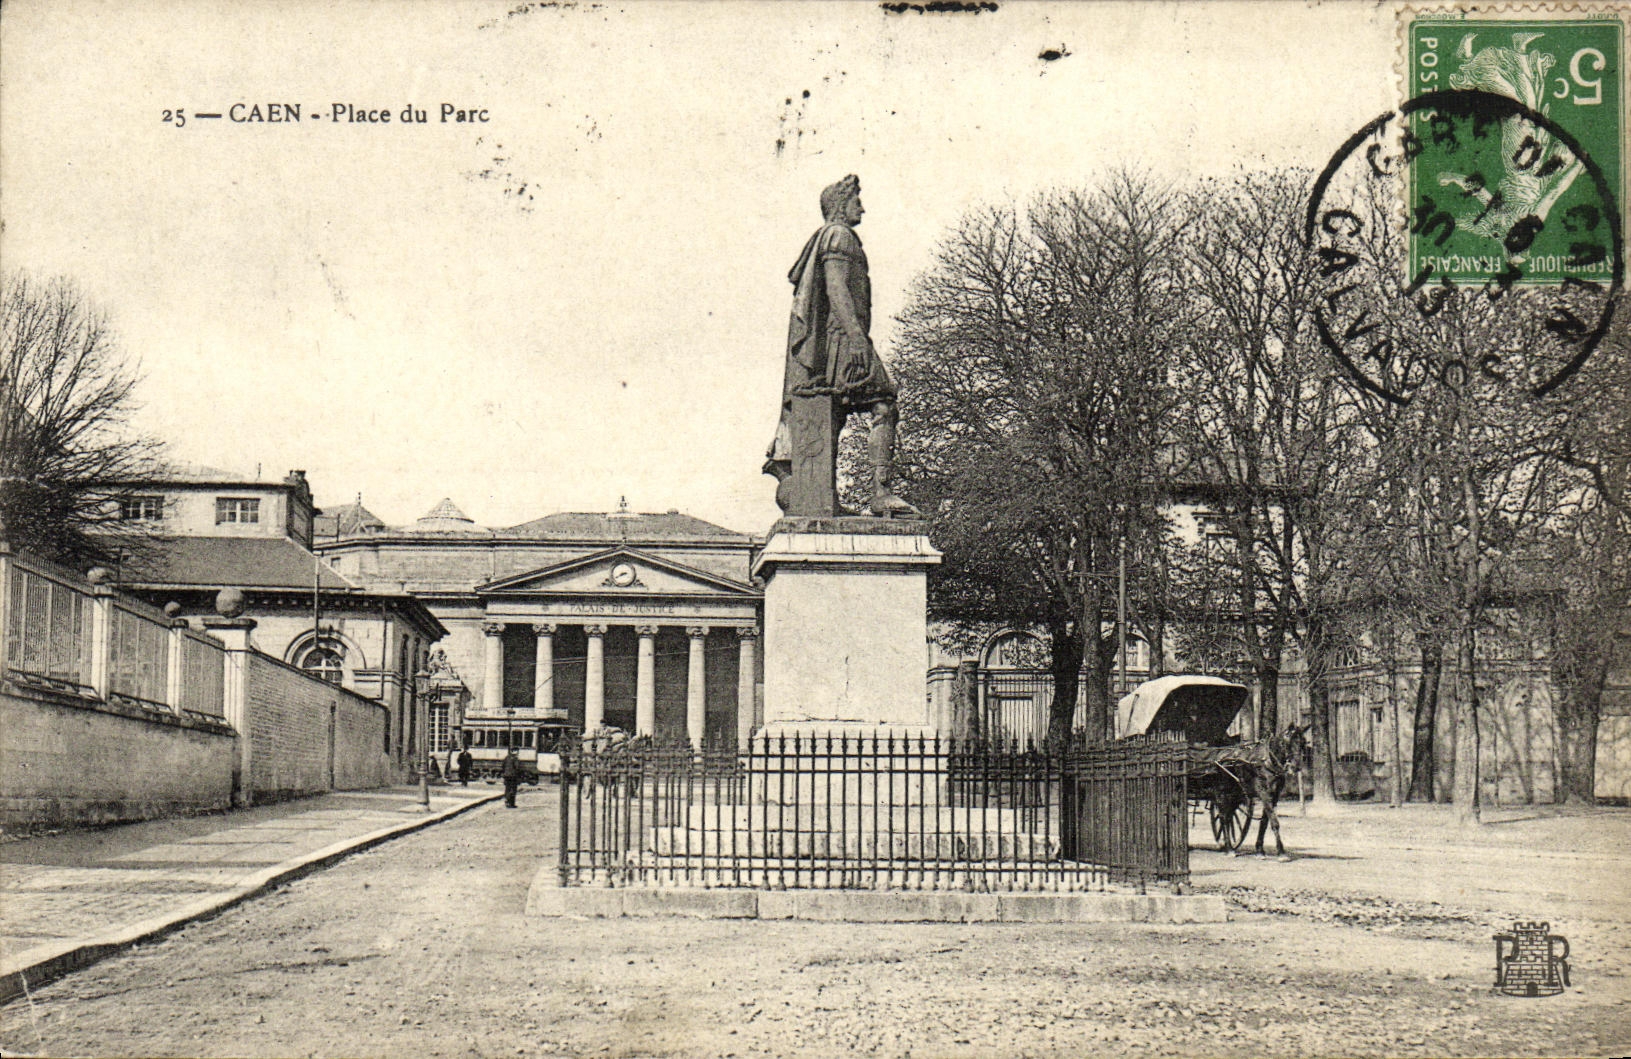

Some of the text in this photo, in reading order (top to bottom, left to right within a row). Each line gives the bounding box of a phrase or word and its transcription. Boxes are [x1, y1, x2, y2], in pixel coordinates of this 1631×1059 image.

[1420, 37, 1438, 122] POSTS
[570, 604, 675, 614] PALAIS DE JUSTICE
